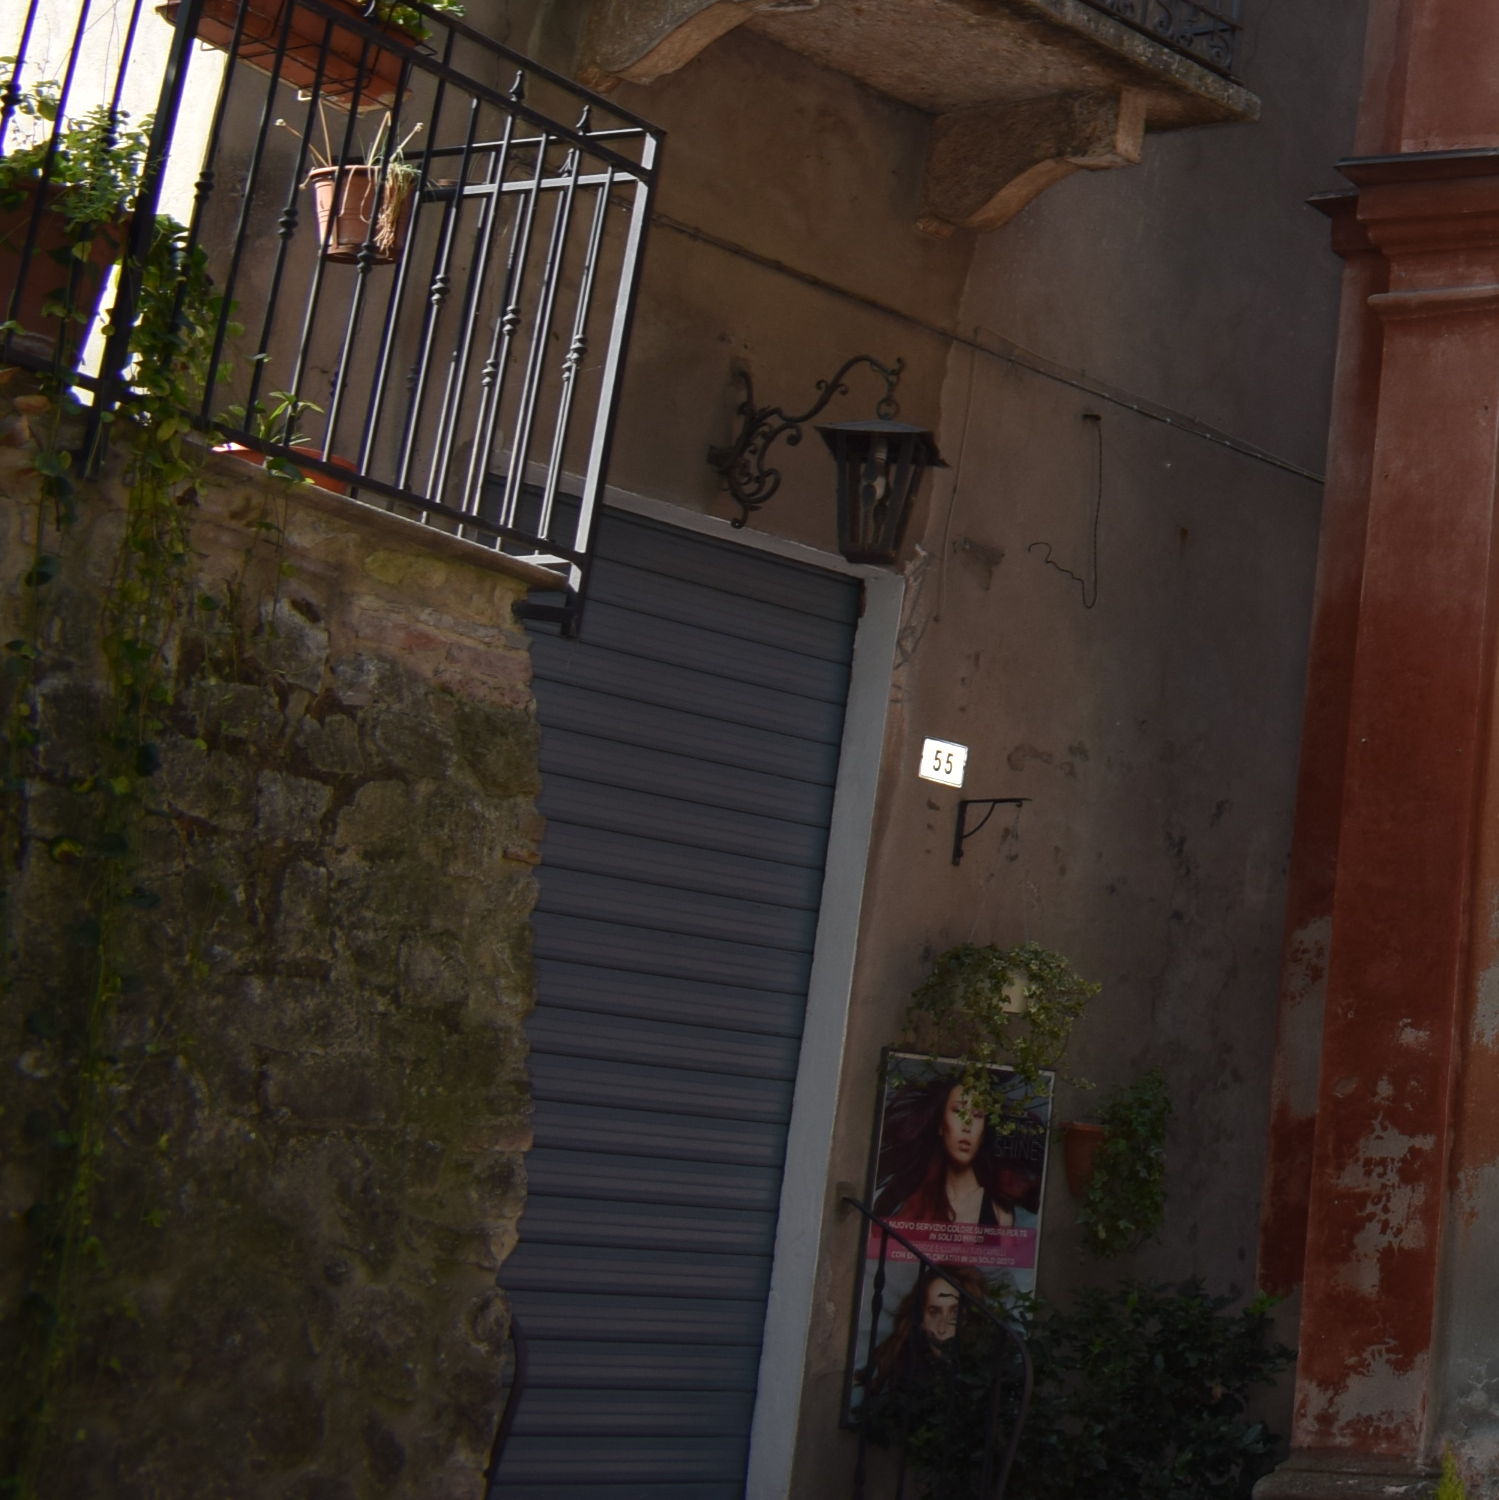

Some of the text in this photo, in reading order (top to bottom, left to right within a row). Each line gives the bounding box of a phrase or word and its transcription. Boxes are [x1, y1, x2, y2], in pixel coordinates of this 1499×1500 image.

[932, 749, 954, 775] 55
[889, 1220, 915, 1230] NUOVO
[916, 1222, 947, 1232] SERVIZIO
